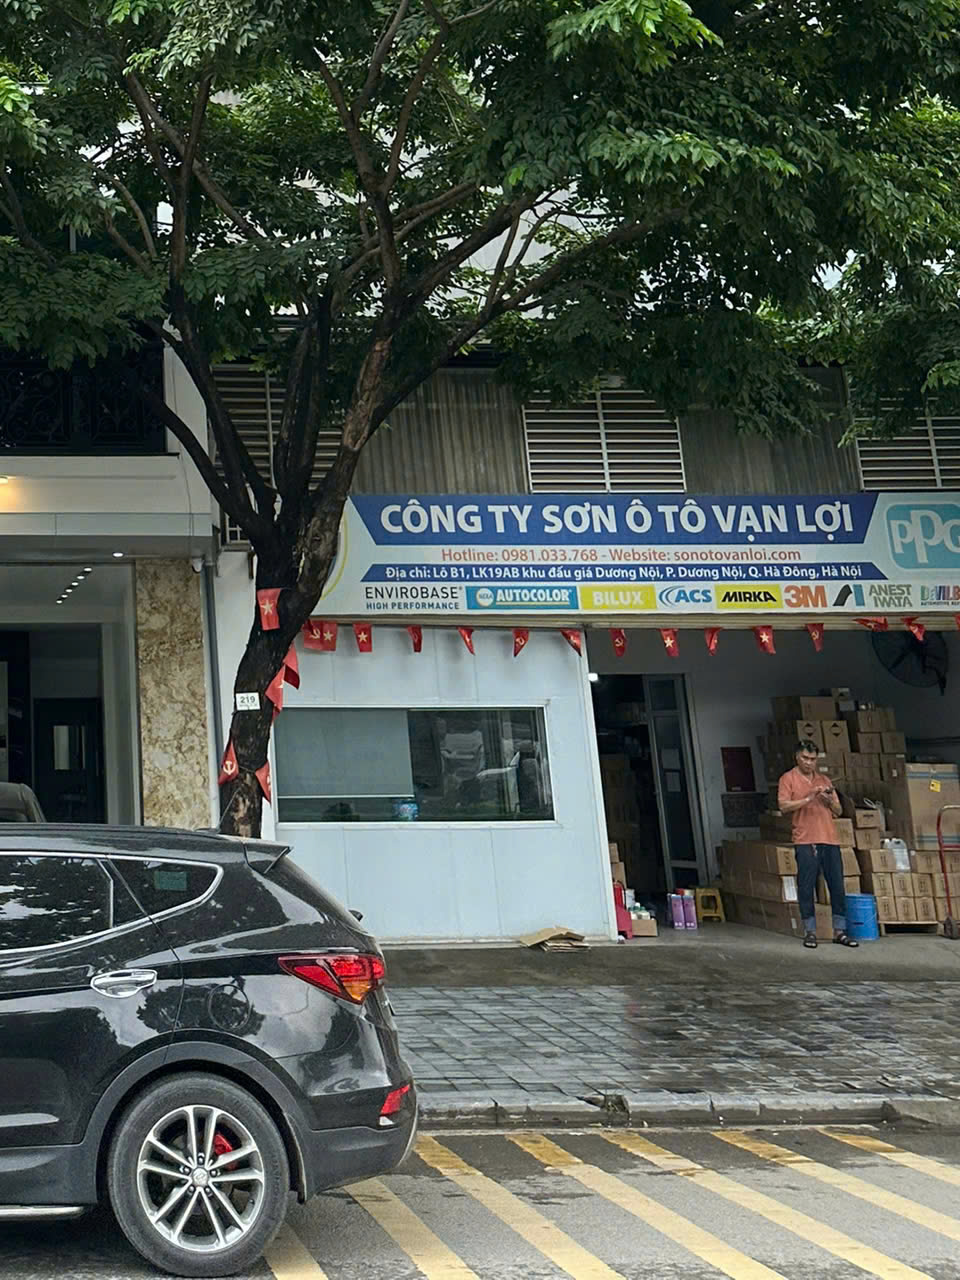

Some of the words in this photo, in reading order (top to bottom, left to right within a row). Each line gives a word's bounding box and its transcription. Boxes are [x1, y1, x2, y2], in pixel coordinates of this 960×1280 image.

[380, 499, 483, 534] CÔNG
[488, 505, 533, 533] TY
[542, 502, 617, 534] SƠN
[625, 499, 652, 534] Ô
[657, 499, 707, 534] TÔ
[712, 504, 788, 542] VẠN
[796, 501, 853, 542] LỢI
[442, 548, 499, 561] Hotline:
[502, 549, 598, 561] 0981.033.768
[609, 548, 670, 561] Website:
[674, 547, 801, 561] sonotovanloi.com
[385, 566, 407, 581] Địa
[409, 565, 431, 579] chỉ:
[450, 567, 470, 580] B1,
[472, 567, 519, 579] LK19AB
[522, 566, 546, 578] khu
[548, 565, 572, 578] đấu
[574, 566, 593, 580] giá
[595, 567, 637, 580] Dương
[639, 566, 664, 580] Nội,
[665, 567, 676, 578] P.
[678, 567, 719, 580] Dương
[722, 566, 746, 580] Nội,
[748, 566, 762, 578] Q.
[763, 566, 780, 577] Hà
[783, 565, 820, 579] Đông,
[821, 566, 838, 577] Hà
[840, 565, 862, 579] Nội
[365, 586, 459, 599] ENVIROBASE
[496, 589, 569, 602] AUTOCOLOR
[674, 589, 713, 603] ACS
[721, 591, 777, 602] MIRKA
[784, 585, 828, 608] 3M
[869, 584, 912, 596] ANEST
[592, 591, 643, 606] BILUX
[874, 596, 913, 607] IWATA
[391, 602, 460, 610] PERFORMANCE
[239, 695, 256, 704] 219
